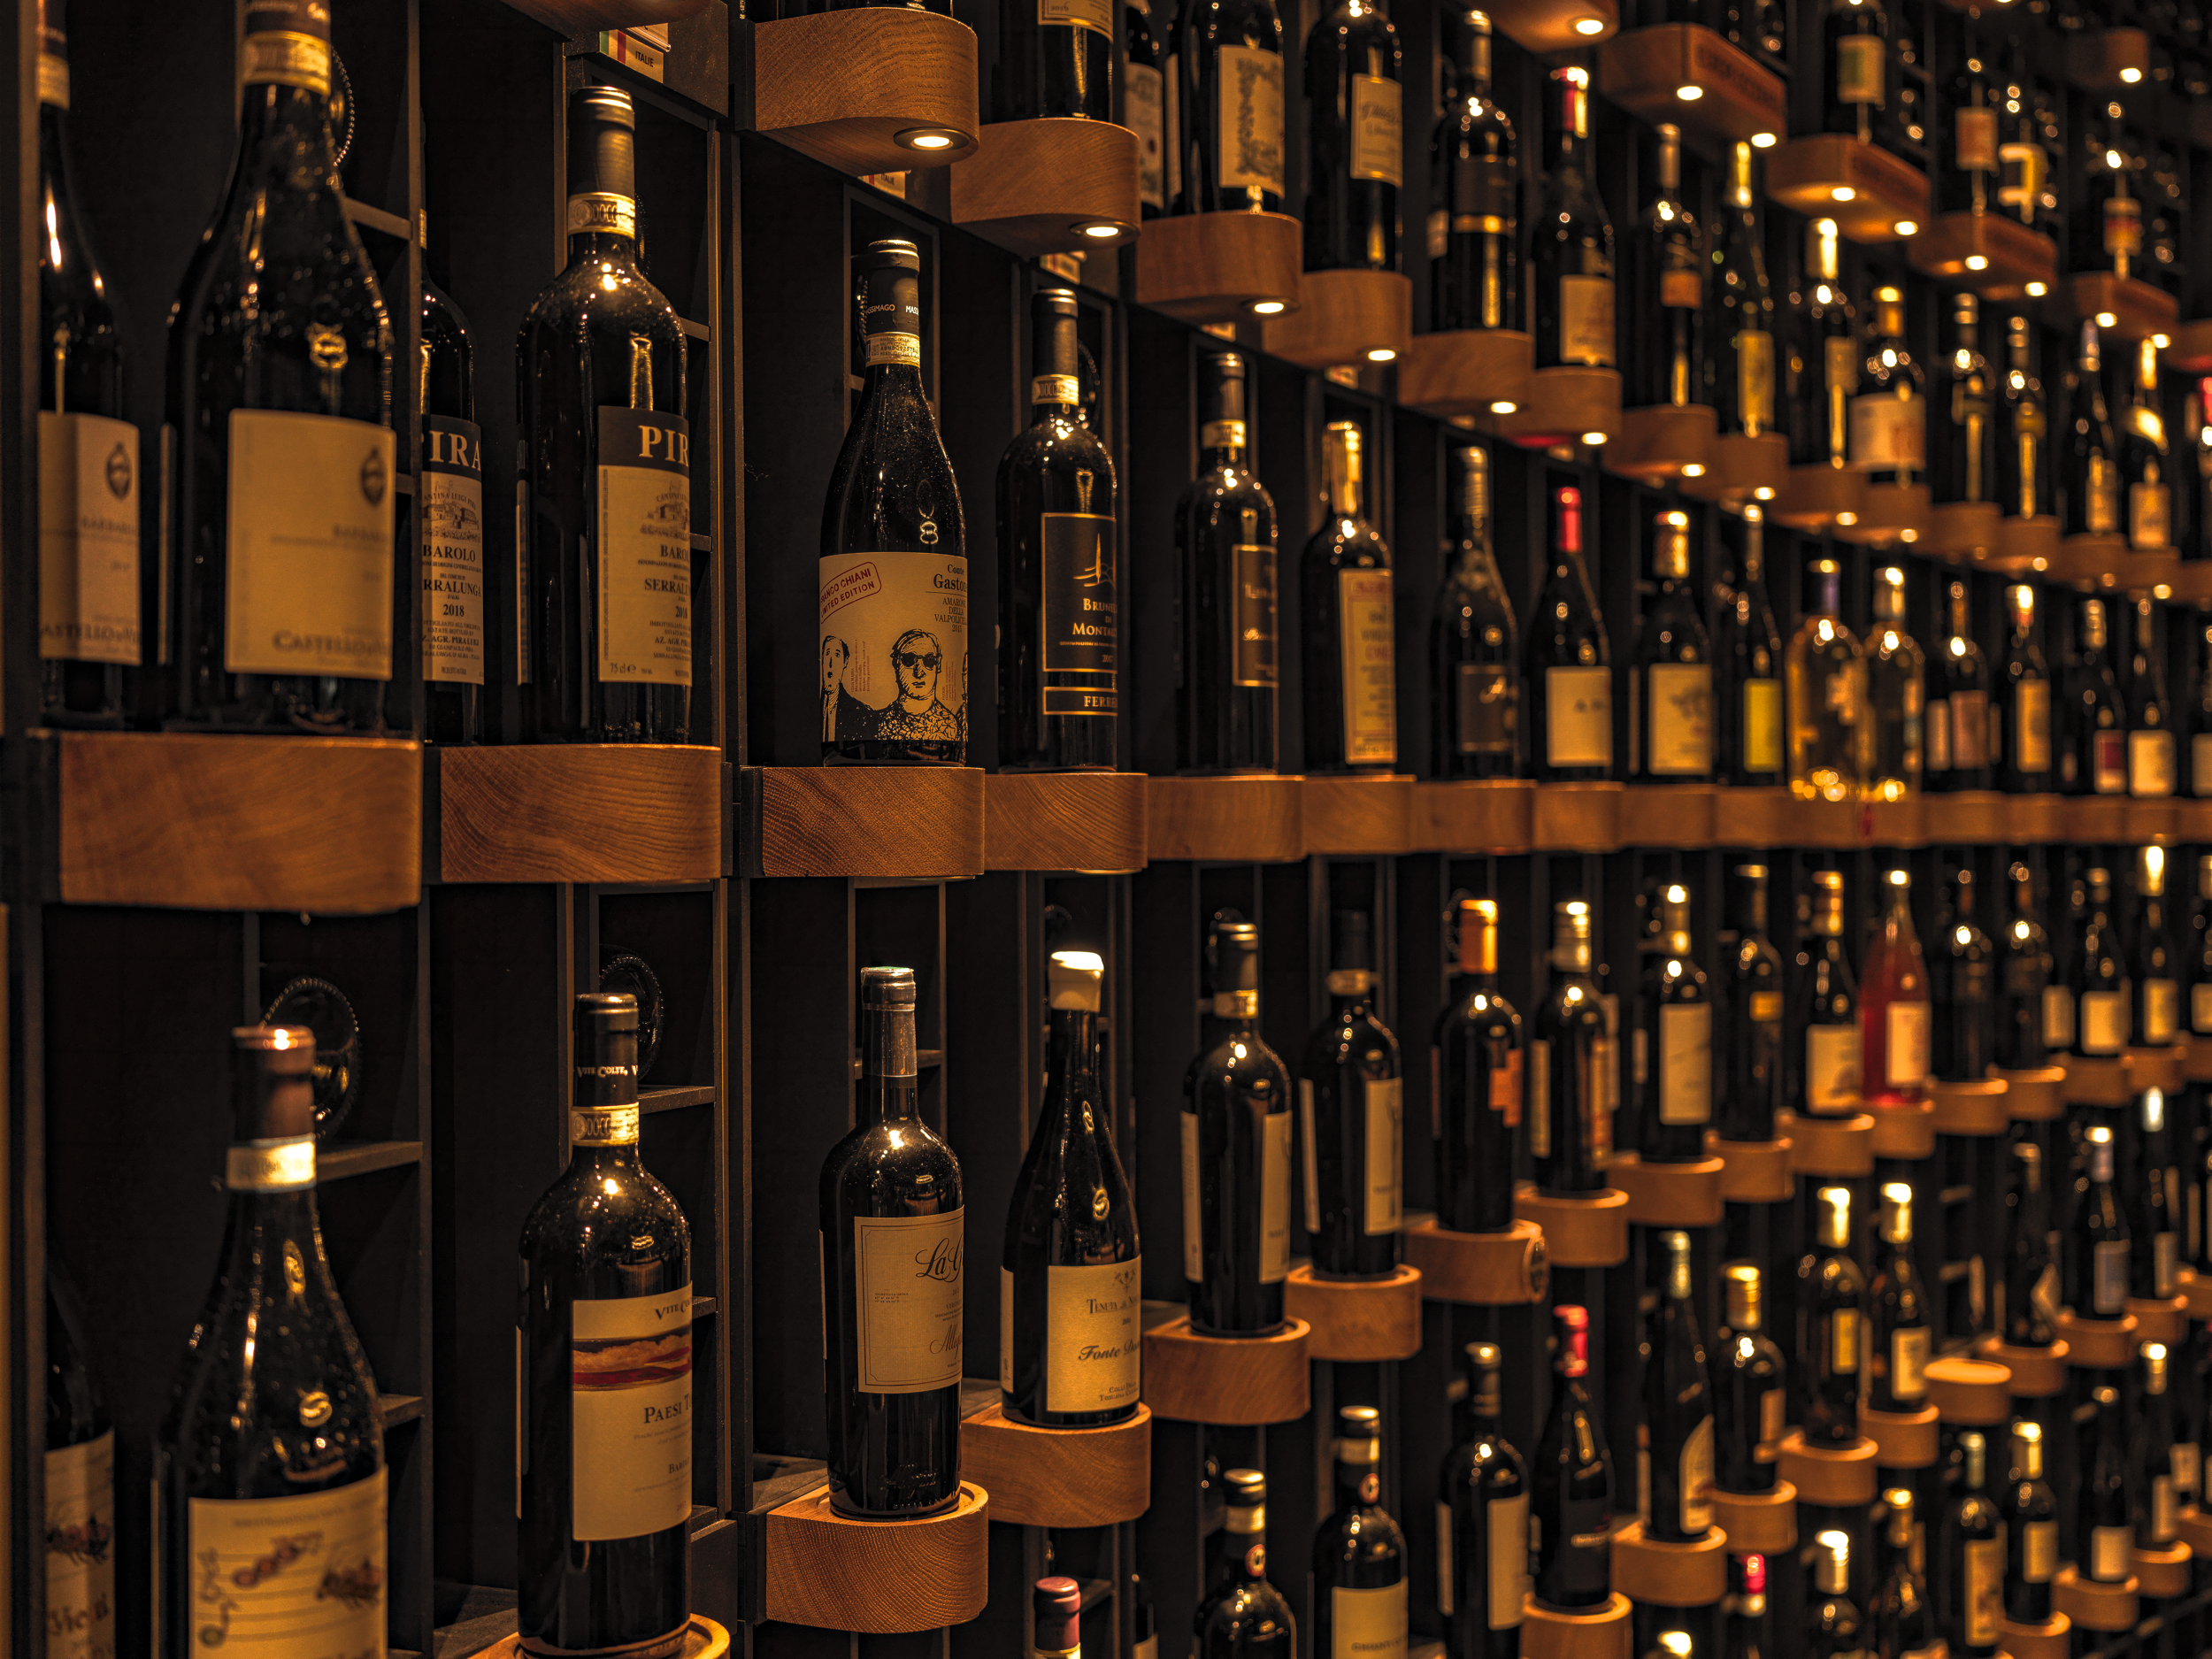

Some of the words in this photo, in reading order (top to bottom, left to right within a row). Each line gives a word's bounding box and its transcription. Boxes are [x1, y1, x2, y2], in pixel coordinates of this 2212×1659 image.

[635, 50, 654, 67] ITALIE
[421, 430, 481, 472] IRA
[423, 544, 476, 563] BAROLO
[840, 567, 872, 592] CHIANI
[840, 580, 875, 605] EDITION
[443, 603, 465, 617] 2018
[577, 1065, 596, 1079] VITE
[656, 1303, 679, 1320] VITE
[1079, 1345, 1120, 1361] Fonte
[644, 1402, 682, 1425] PAESI
